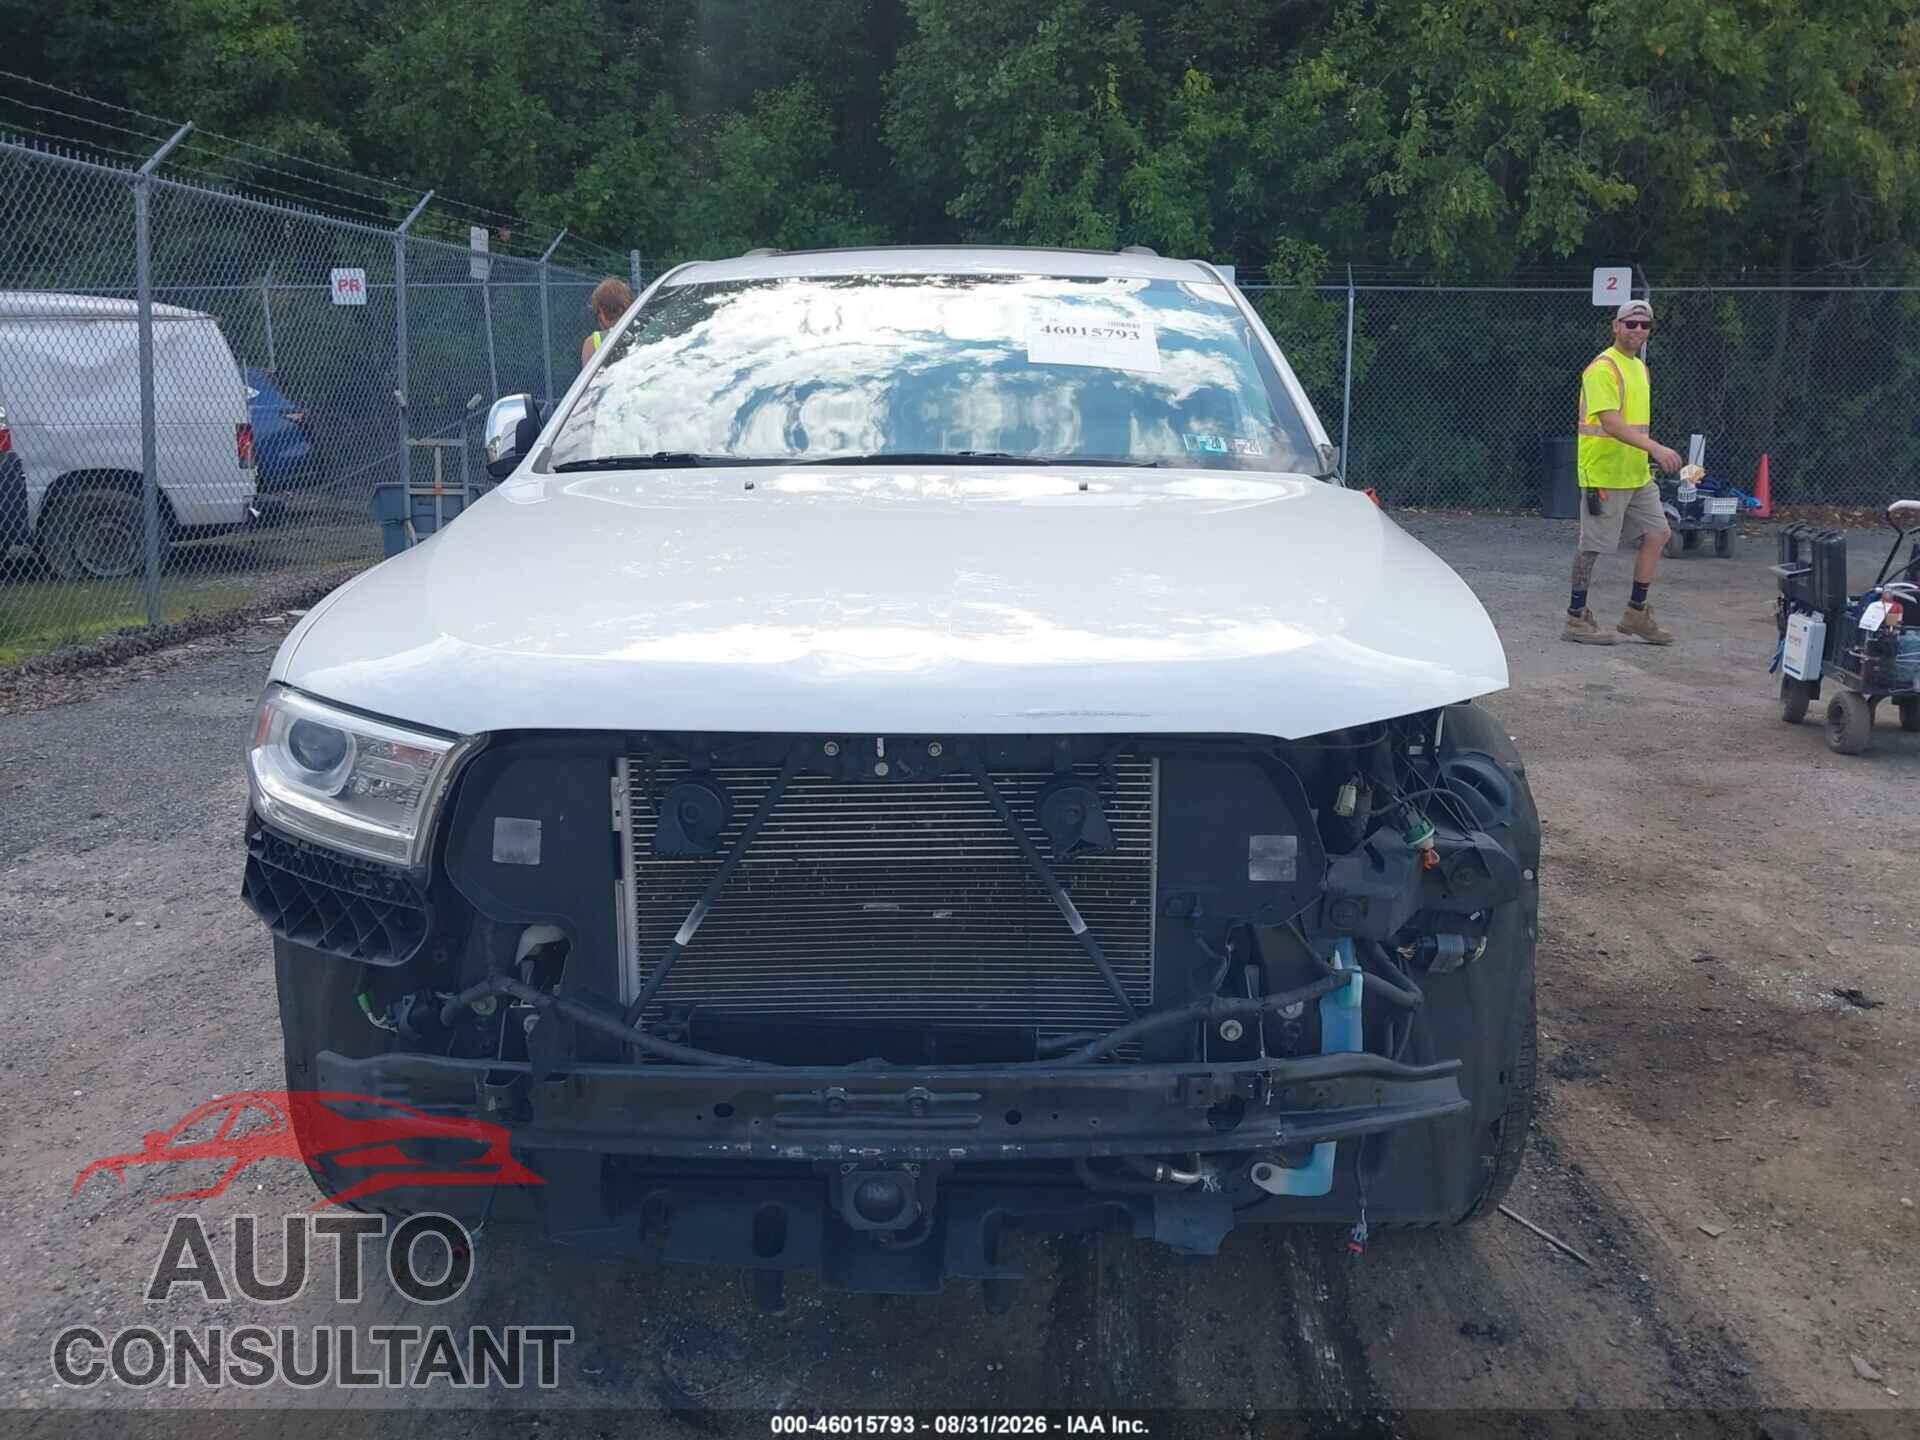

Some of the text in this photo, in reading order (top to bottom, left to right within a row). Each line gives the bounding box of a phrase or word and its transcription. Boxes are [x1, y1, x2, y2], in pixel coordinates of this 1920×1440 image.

[337, 278, 362, 293] PR
[1606, 276, 1618, 290] 2
[1040, 324, 1140, 340] 46015793
